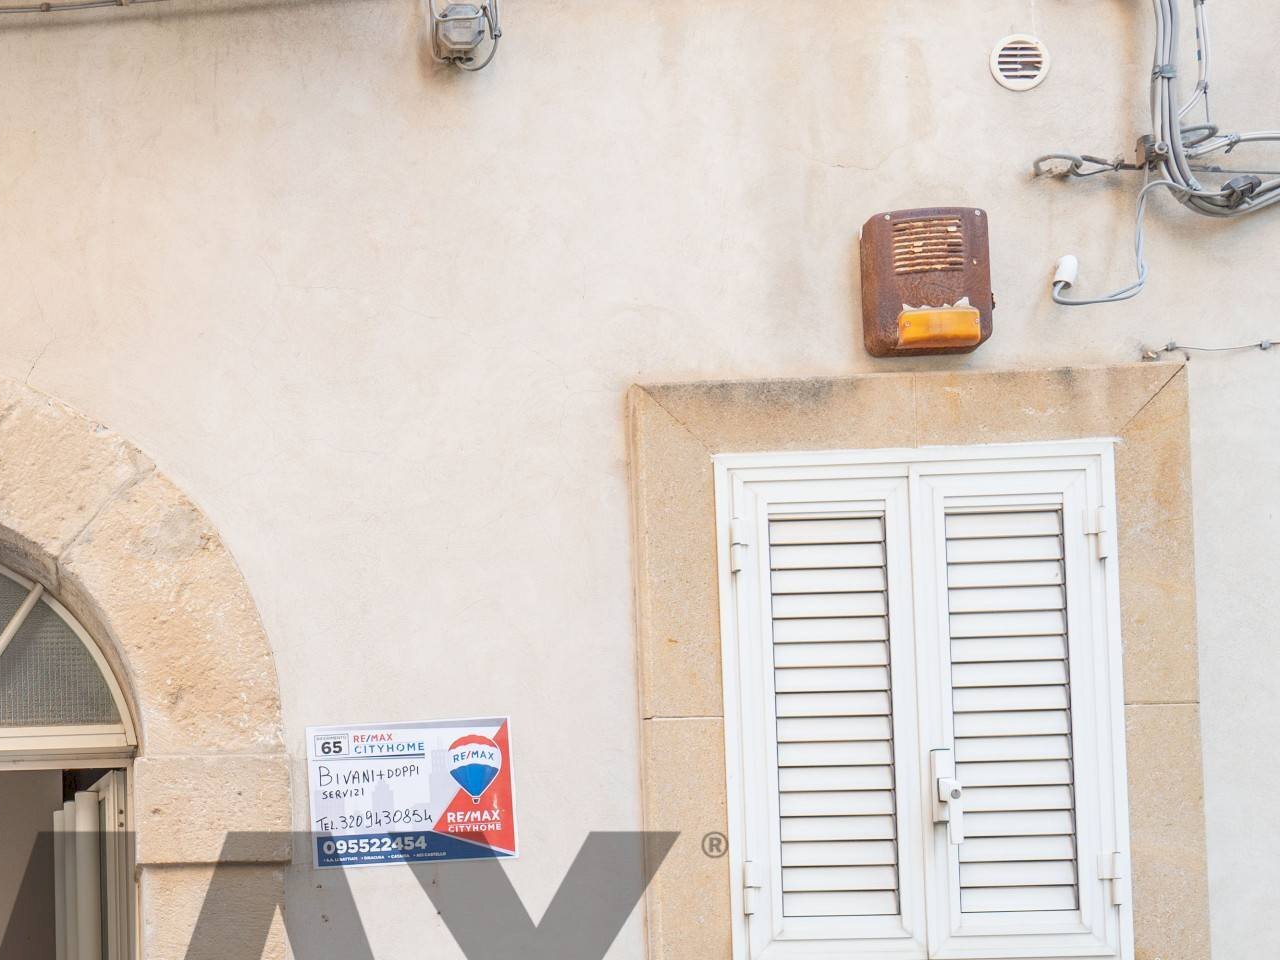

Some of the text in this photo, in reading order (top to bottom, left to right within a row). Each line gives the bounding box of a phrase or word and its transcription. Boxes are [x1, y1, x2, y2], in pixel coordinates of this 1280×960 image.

[321, 741, 343, 754] 65
[354, 742, 425, 754] CITYHOME
[453, 750, 495, 763] RE/MAX
[447, 809, 500, 823] RE/MAX
[448, 823, 502, 833] CITYHOME
[322, 835, 427, 855] 095522454
